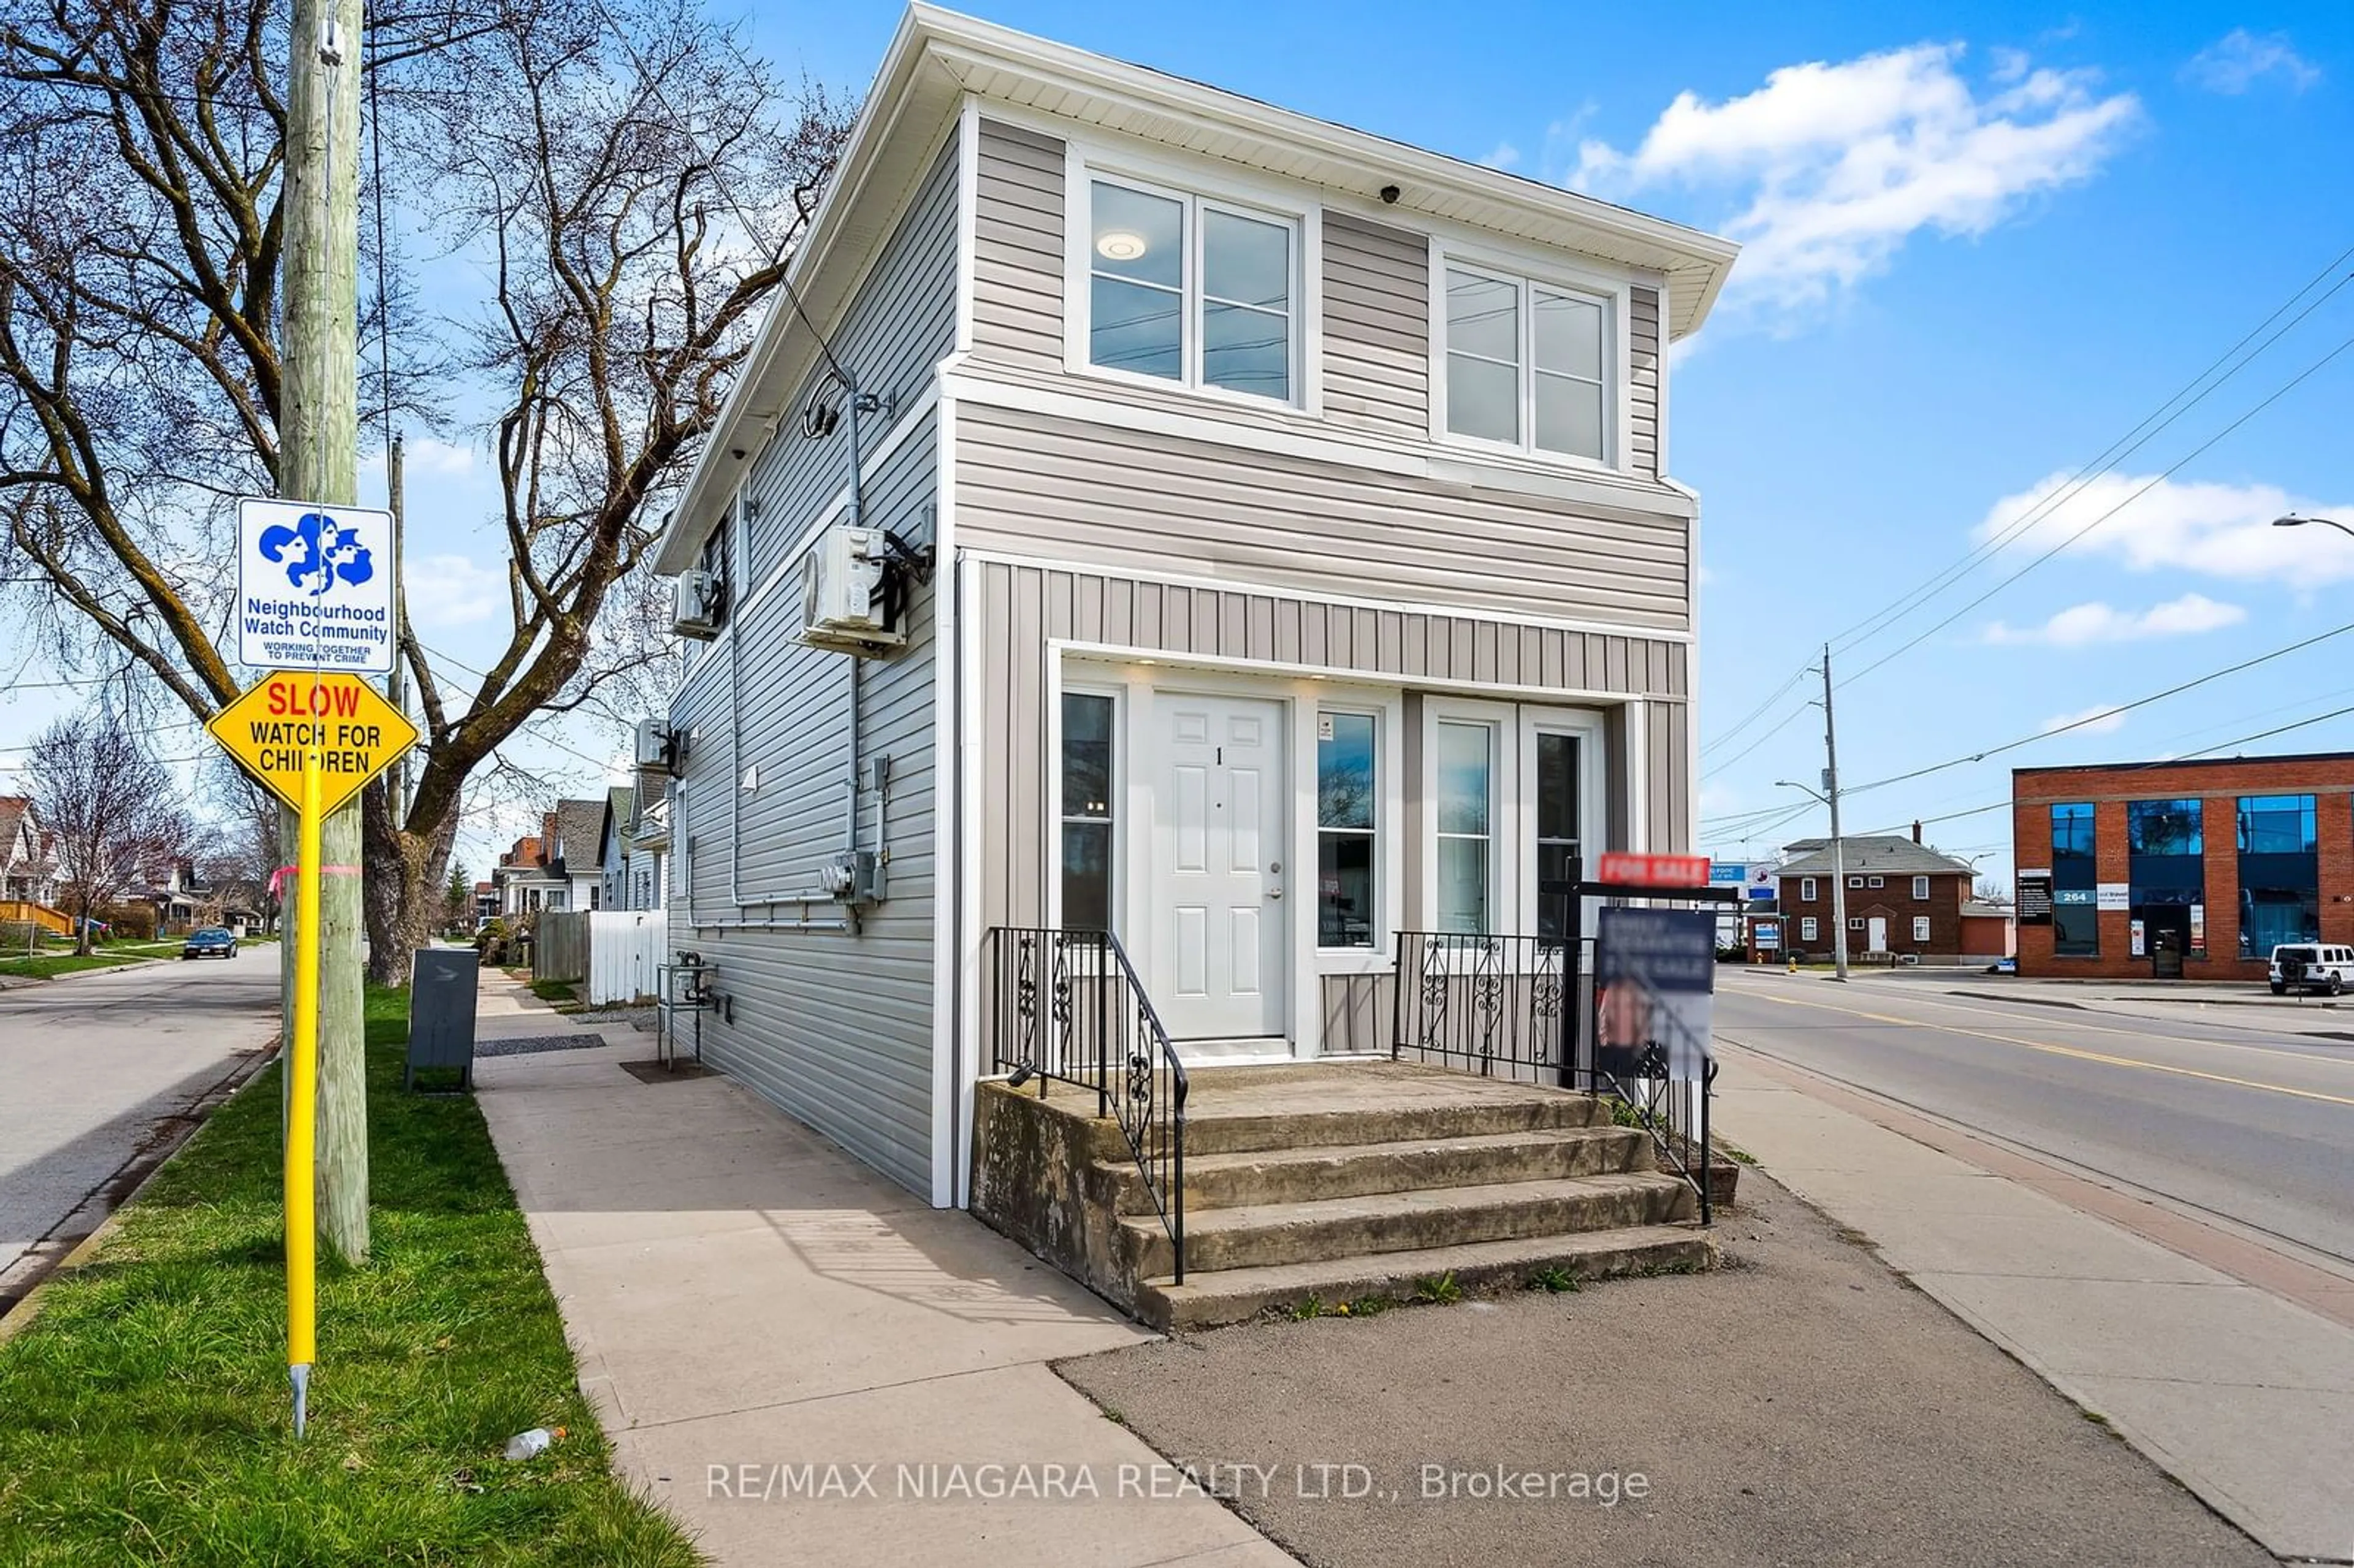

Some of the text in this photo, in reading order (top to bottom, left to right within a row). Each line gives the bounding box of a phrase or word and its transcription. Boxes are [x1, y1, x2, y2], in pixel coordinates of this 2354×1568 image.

[248, 598, 385, 622] Neighbourhood
[245, 618, 387, 645] Watch Community
[264, 642, 370, 655] WORKING OGETHER
[268, 650, 282, 660] TO
[334, 653, 366, 664] CRIME
[268, 682, 360, 718] SLOW
[250, 721, 380, 748] WATCH FOR
